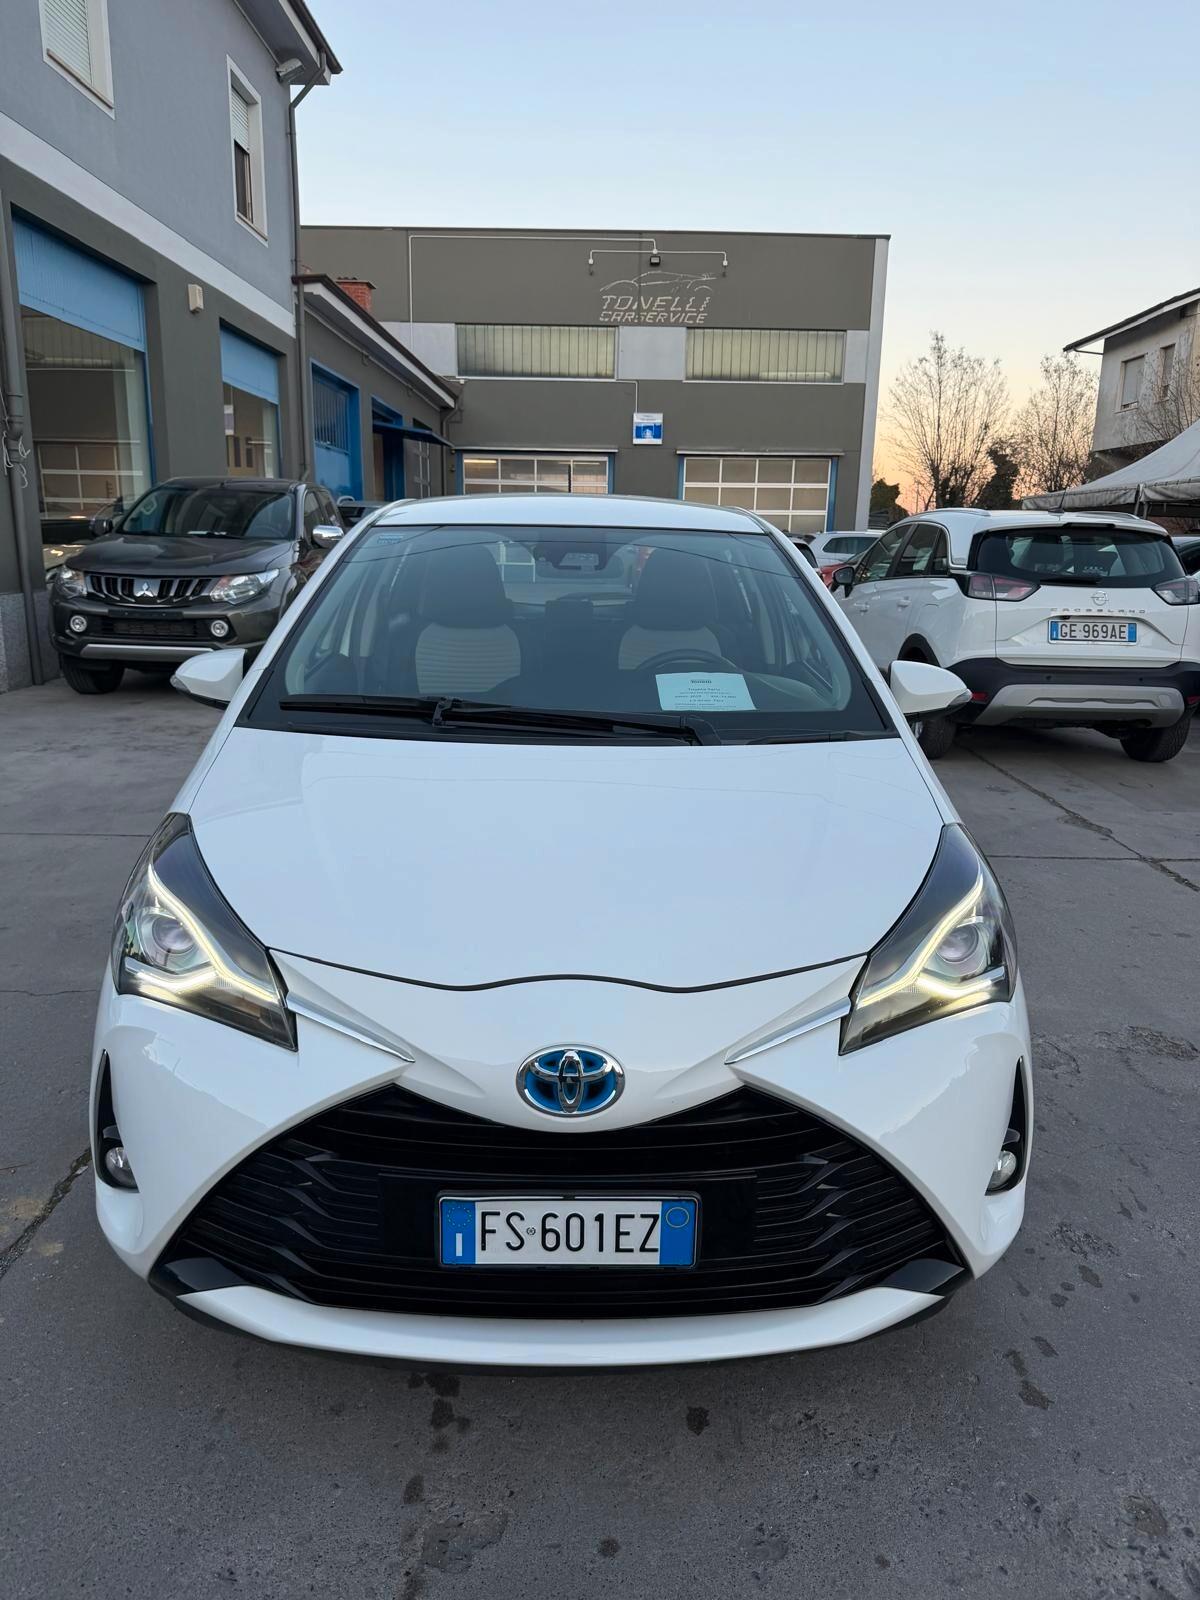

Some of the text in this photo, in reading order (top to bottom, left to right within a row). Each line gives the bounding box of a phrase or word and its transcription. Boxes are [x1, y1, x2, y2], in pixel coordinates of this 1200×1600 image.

[602, 295, 711, 311] TONELLI
[1060, 623, 1077, 638] GE
[1082, 624, 1127, 639] 969AE
[481, 1211, 525, 1251] FS
[541, 1212, 660, 1253] 601EZ
